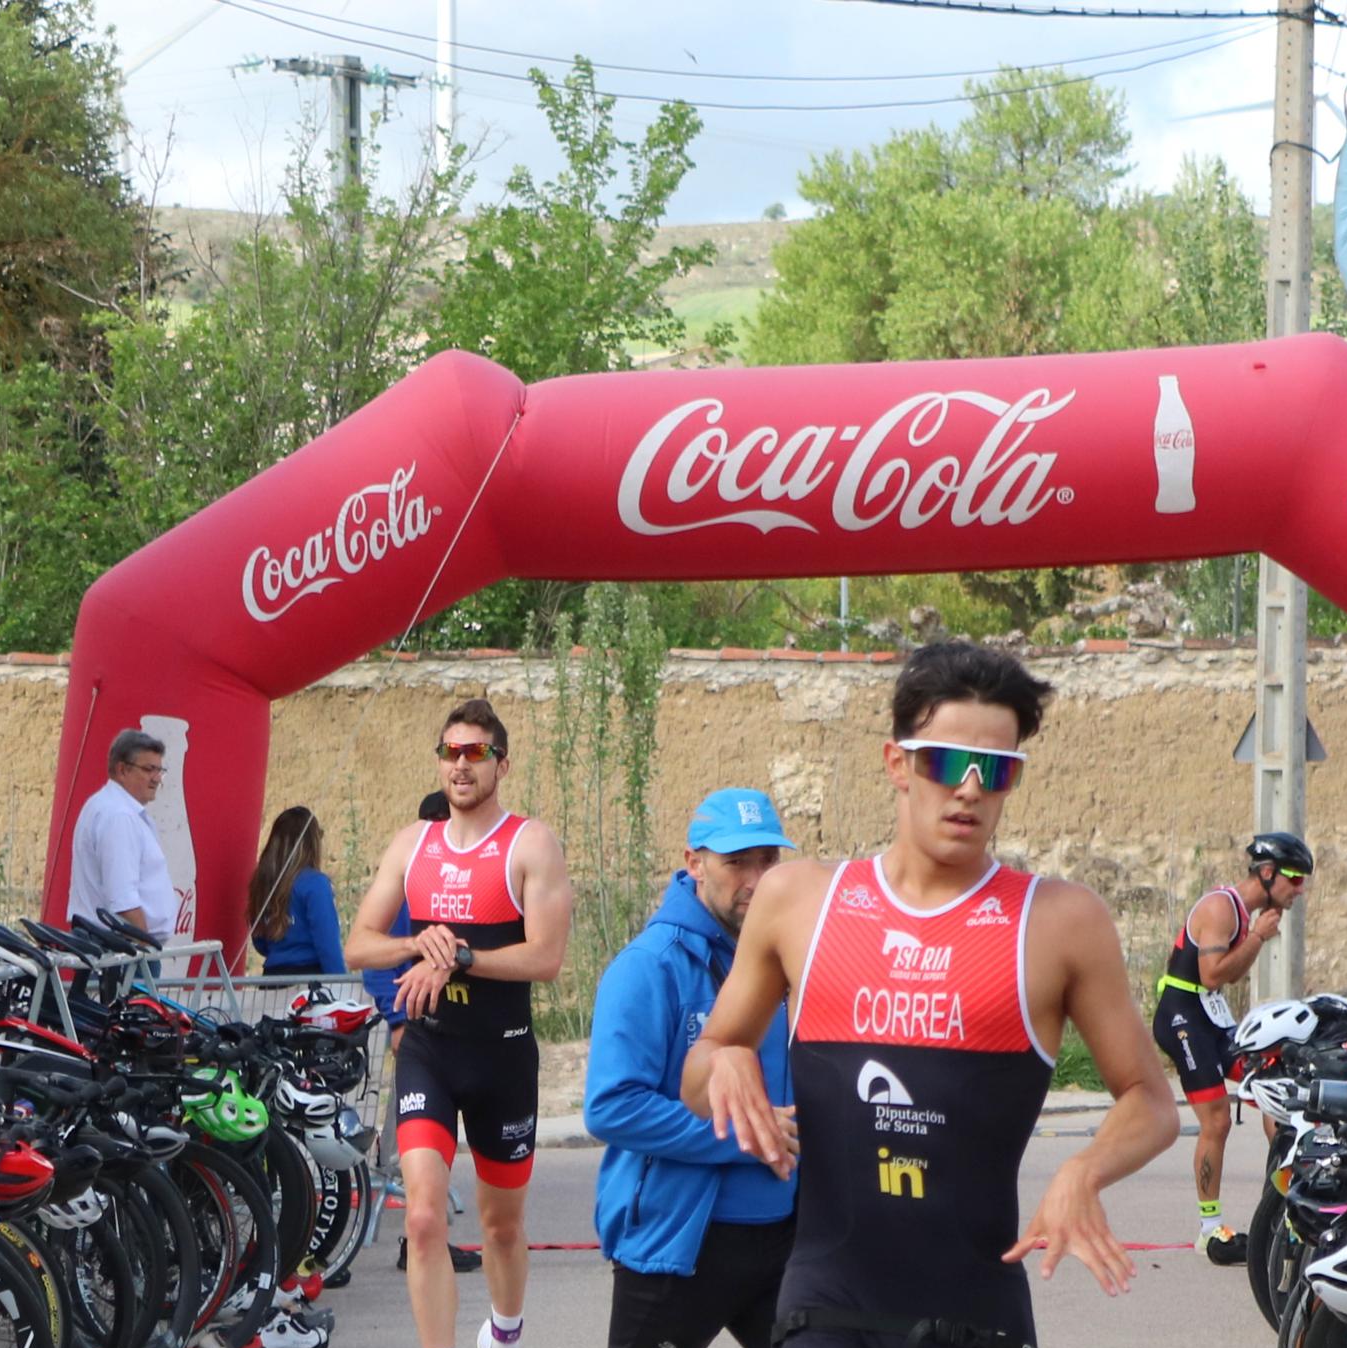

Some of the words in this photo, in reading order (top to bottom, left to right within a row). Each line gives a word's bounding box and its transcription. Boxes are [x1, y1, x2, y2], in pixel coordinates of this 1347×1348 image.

[618, 388, 1076, 535] Coca-Cola
[242, 461, 431, 622] Coca-Cola
[431, 889, 474, 919] PÉREZ
[853, 985, 966, 1042] CORREA
[503, 1026, 529, 1038] 2XU
[875, 1117, 891, 1131] de
[894, 1120, 928, 1135] Soria
[876, 1105, 946, 1125] Diputación
[890, 1156, 929, 1170] JOVEN
